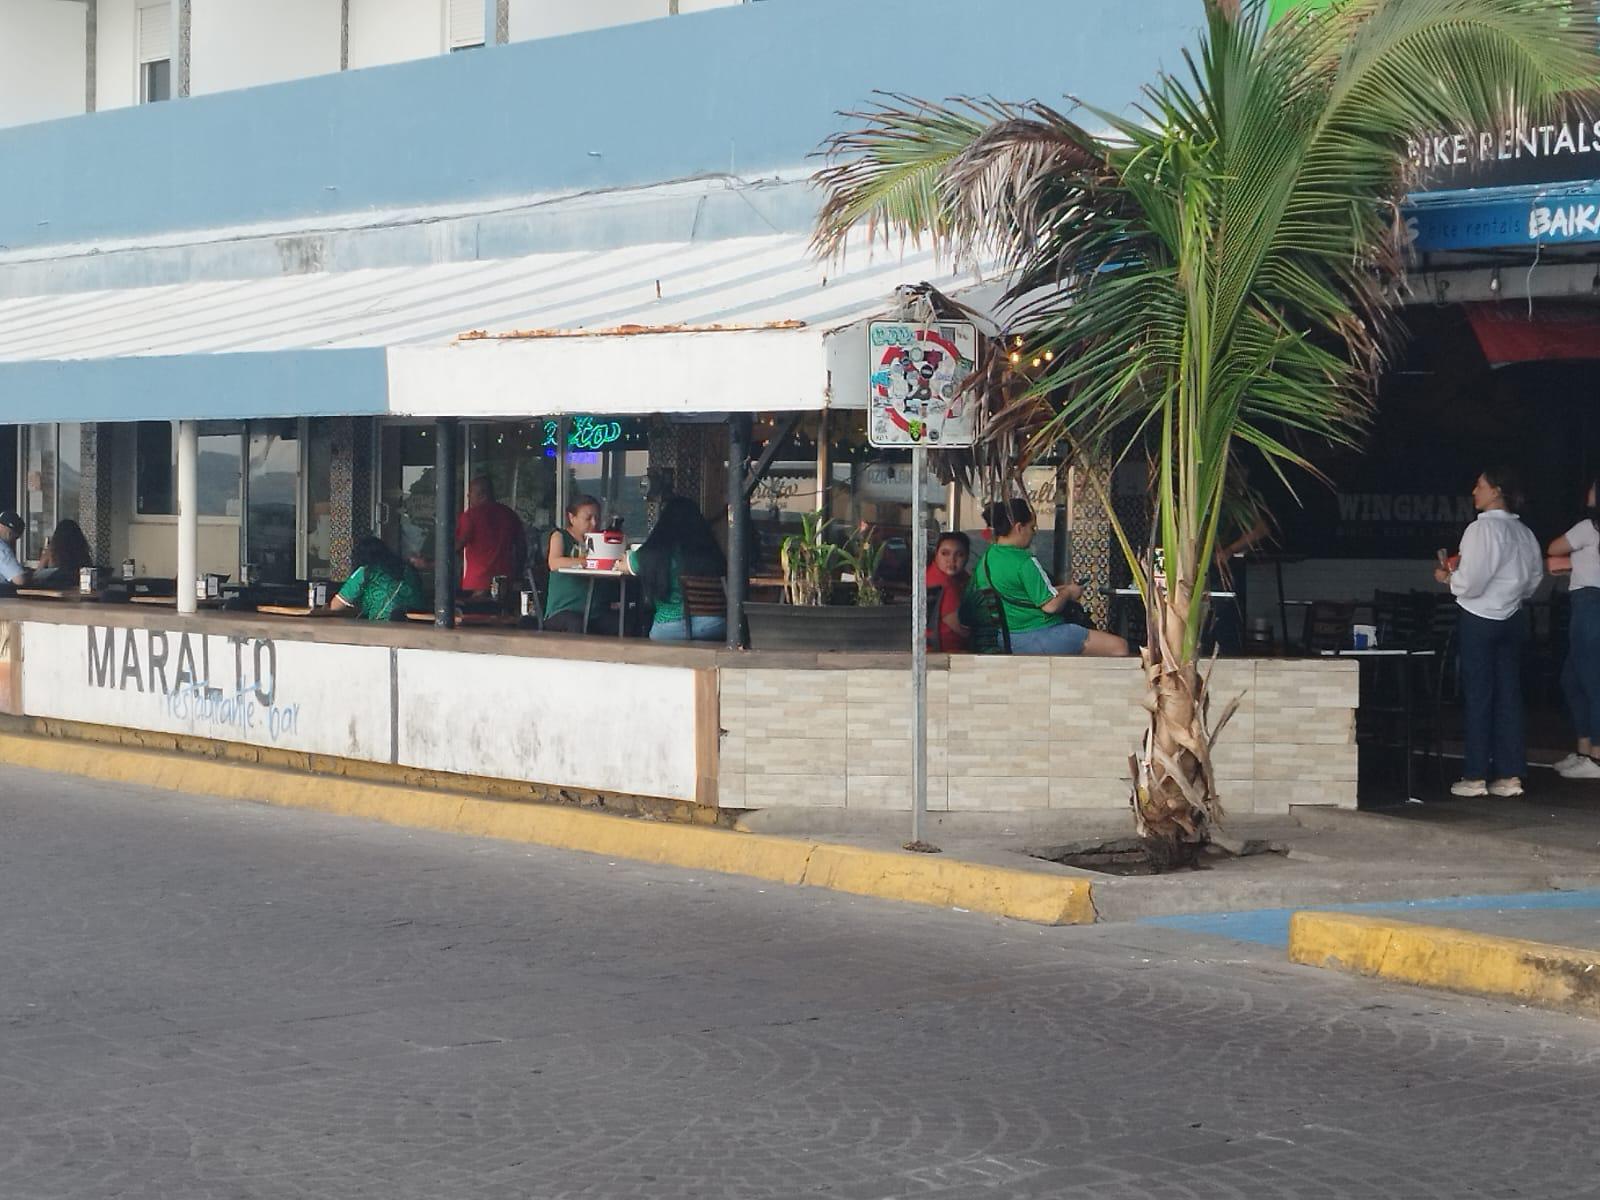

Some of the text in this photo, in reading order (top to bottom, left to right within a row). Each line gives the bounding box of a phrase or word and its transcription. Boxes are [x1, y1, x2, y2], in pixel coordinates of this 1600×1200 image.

[1479, 120, 1600, 161] RENTALS
[1464, 214, 1521, 237] rentals
[86, 624, 278, 708] MARALTO
[268, 678, 301, 741] bar
